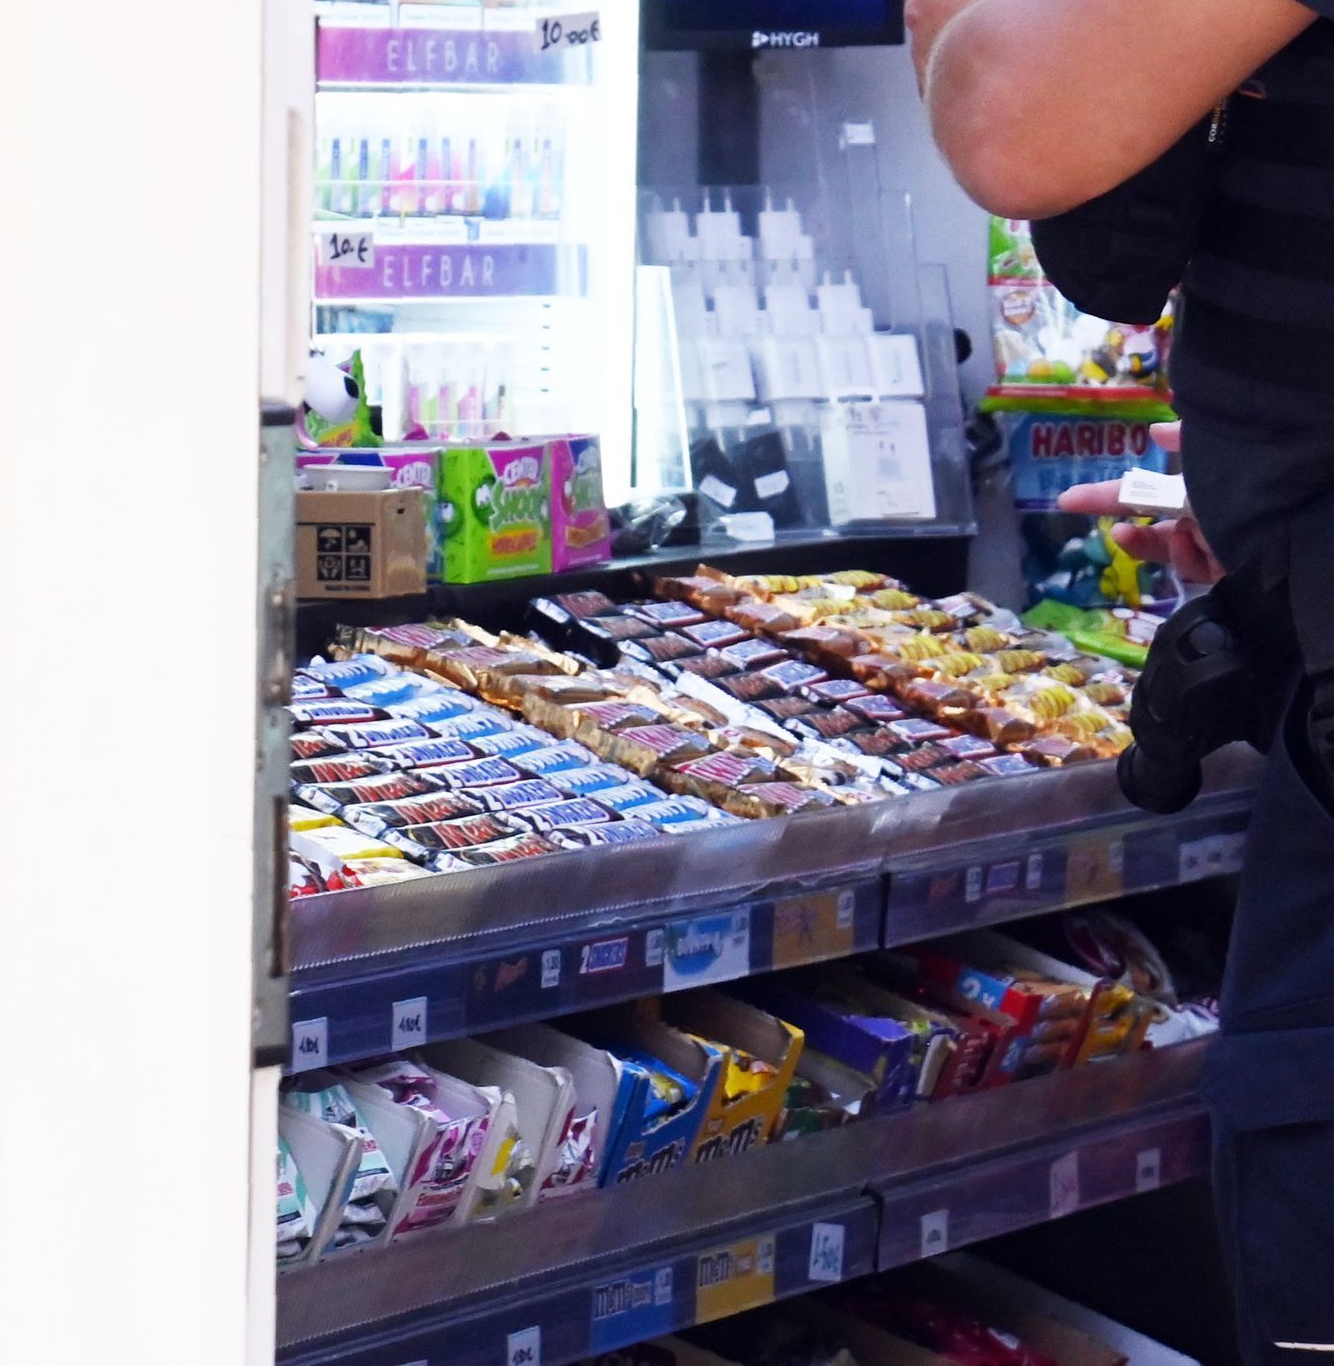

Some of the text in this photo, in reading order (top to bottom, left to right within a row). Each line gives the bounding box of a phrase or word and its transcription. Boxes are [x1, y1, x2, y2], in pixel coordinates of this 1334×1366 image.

[387, 38, 500, 74] ELFBAR
[770, 30, 819, 47] HYGH
[382, 254, 495, 289] ELFBAR
[1032, 423, 1149, 459] HARIBO
